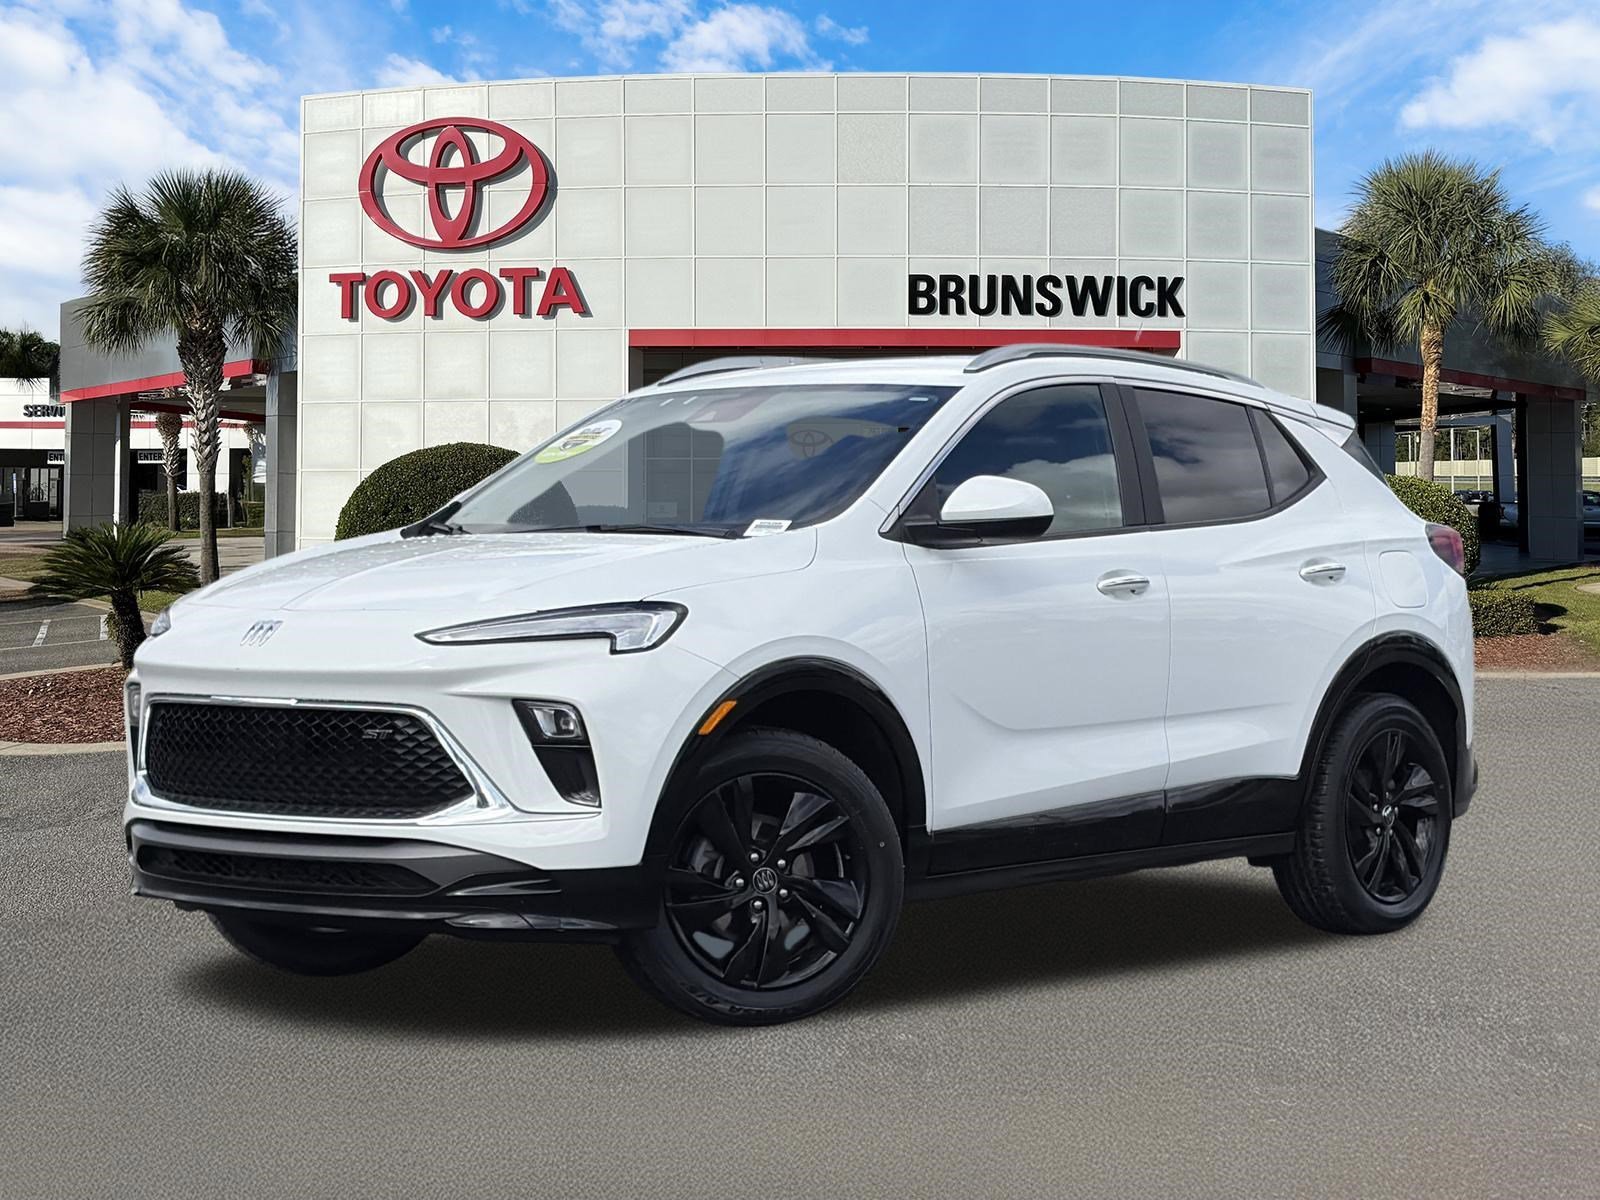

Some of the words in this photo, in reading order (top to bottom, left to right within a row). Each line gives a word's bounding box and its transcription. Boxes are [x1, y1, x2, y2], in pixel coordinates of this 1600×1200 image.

[329, 267, 587, 319] TOYOTA
[908, 274, 1186, 318] BRUNSWICK
[23, 404, 66, 418] SERVI
